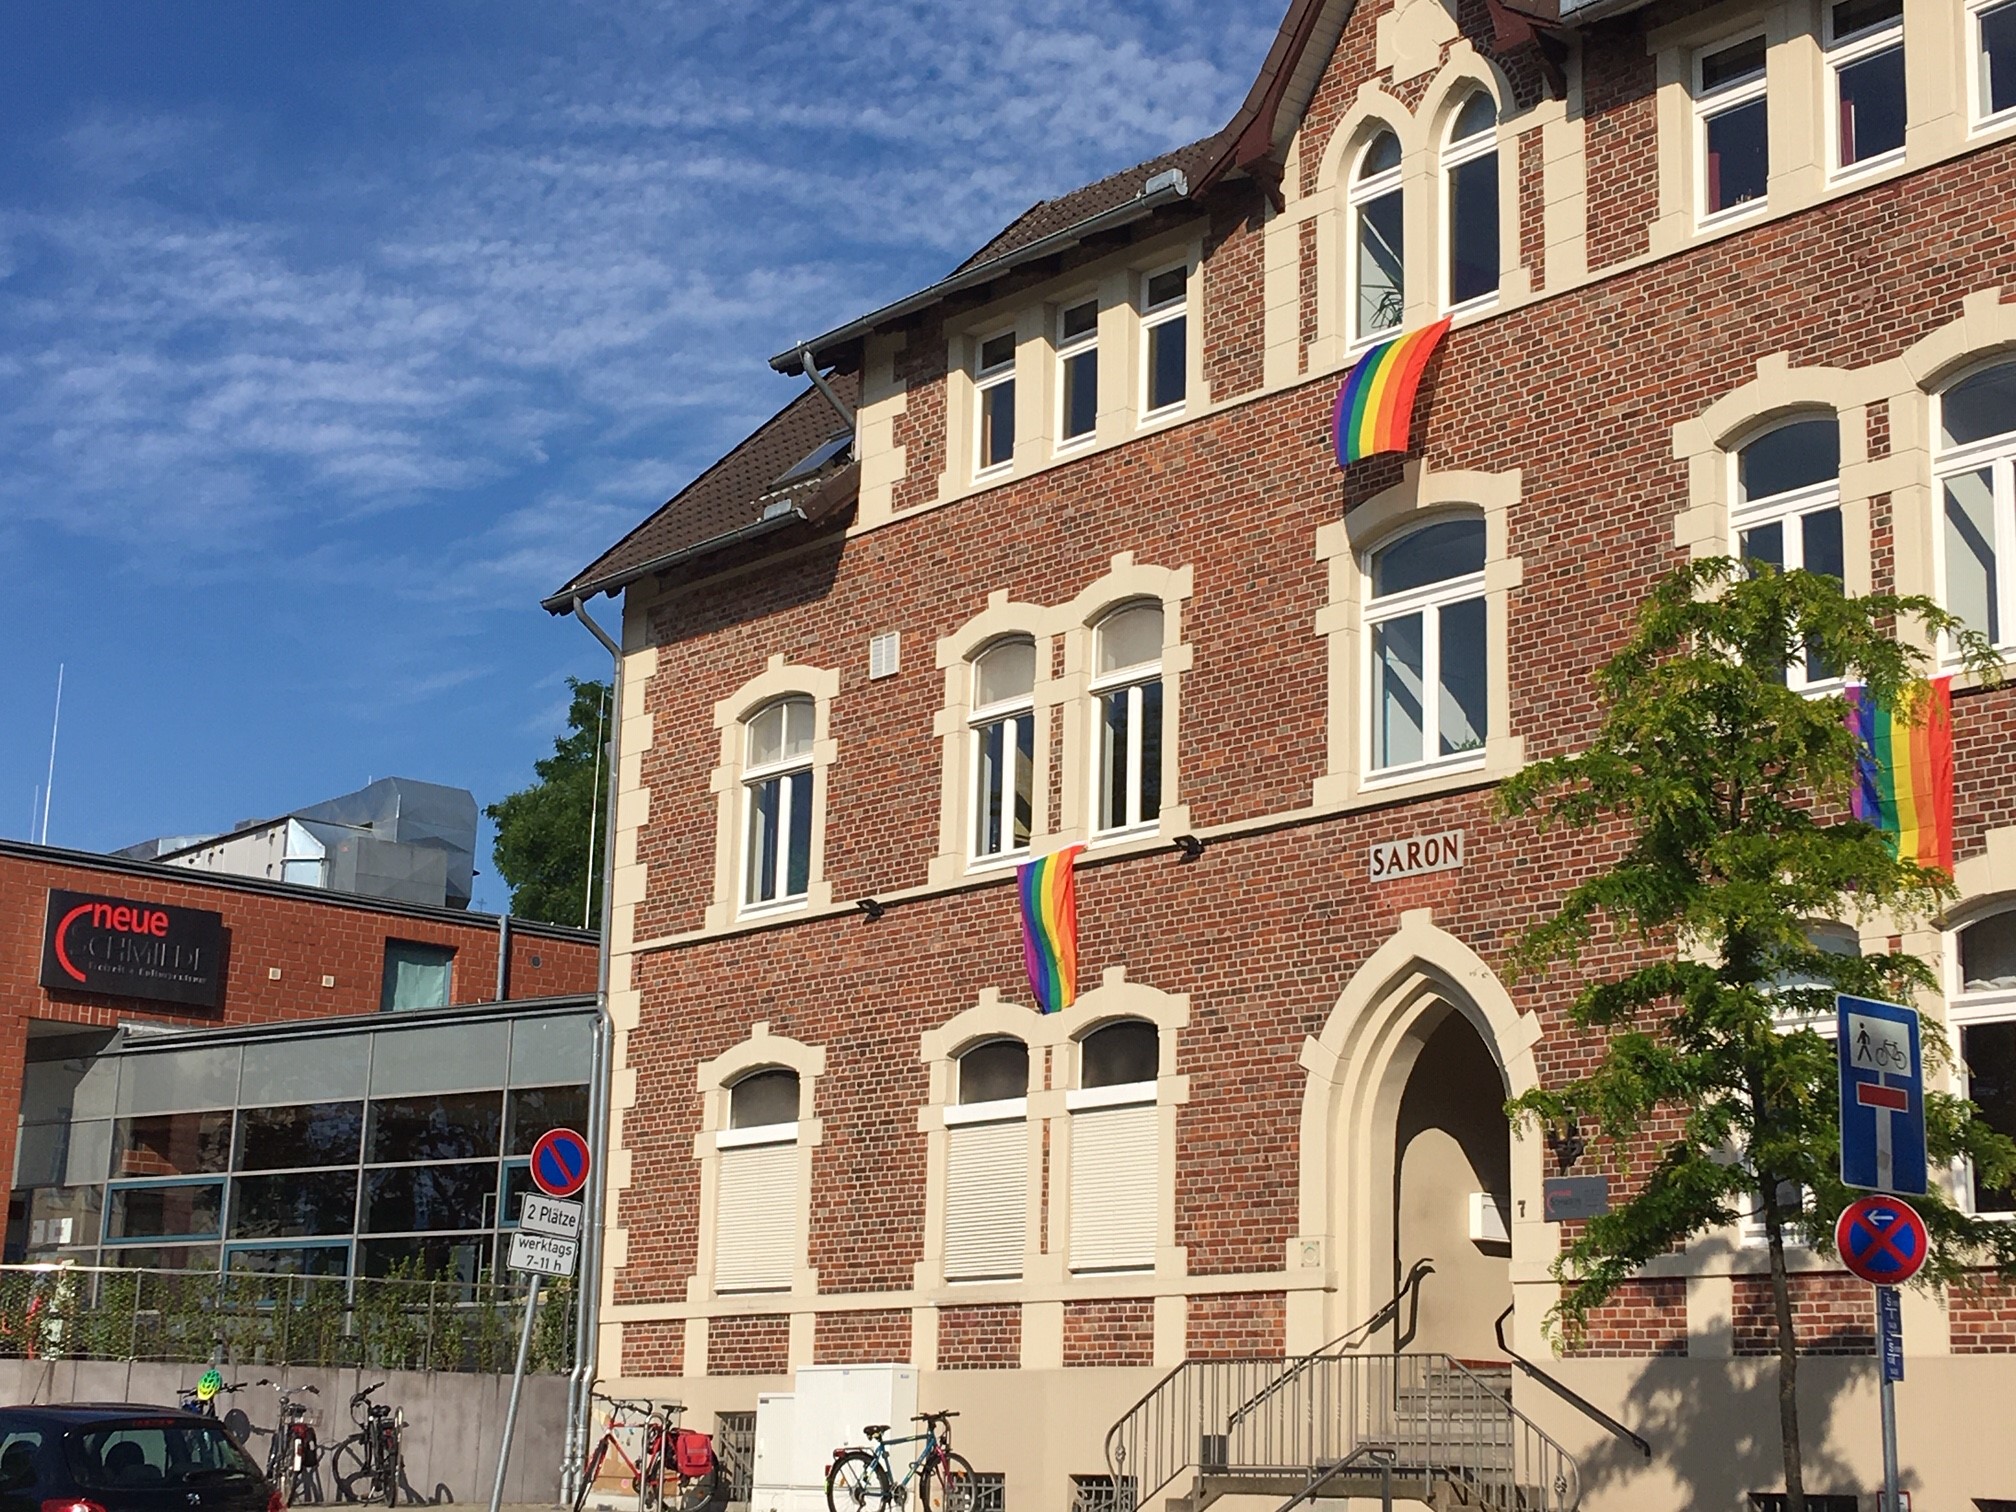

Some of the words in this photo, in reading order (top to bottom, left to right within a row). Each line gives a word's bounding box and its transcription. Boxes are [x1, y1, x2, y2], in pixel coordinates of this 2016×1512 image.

[1373, 834, 1458, 876] SARON
[93, 903, 169, 937] neue
[527, 1204, 536, 1220] 2
[539, 1206, 576, 1227] Plätze
[1517, 1200, 1526, 1218] 7
[519, 1238, 573, 1257] werktags
[526, 1255, 549, 1270] 7-11
[553, 1260, 562, 1271] h
